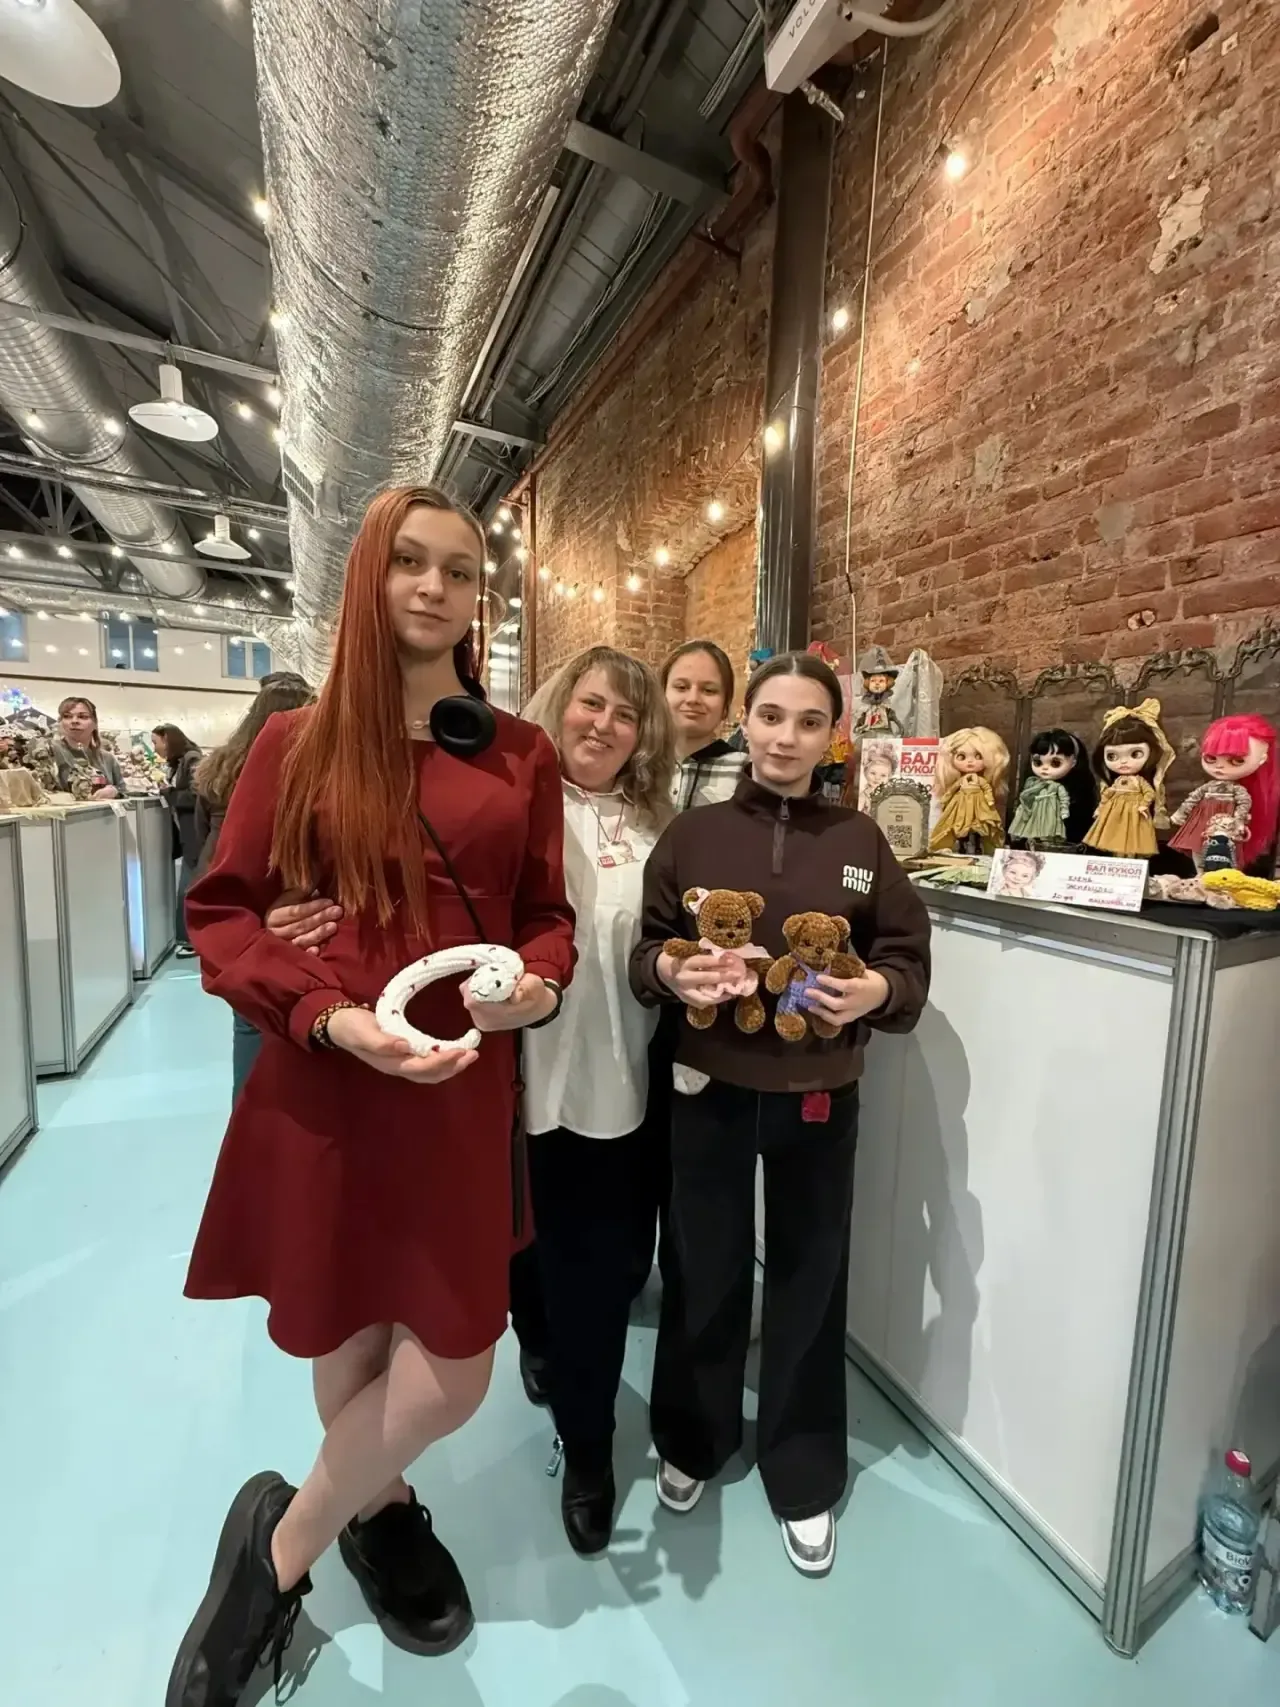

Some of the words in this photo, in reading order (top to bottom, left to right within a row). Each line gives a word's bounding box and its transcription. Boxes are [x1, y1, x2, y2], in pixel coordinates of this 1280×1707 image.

[901, 752, 938, 765] БАЛ
[1086, 864, 1107, 873] БАЛ
[1107, 866, 1142, 875] КУКОЛ
